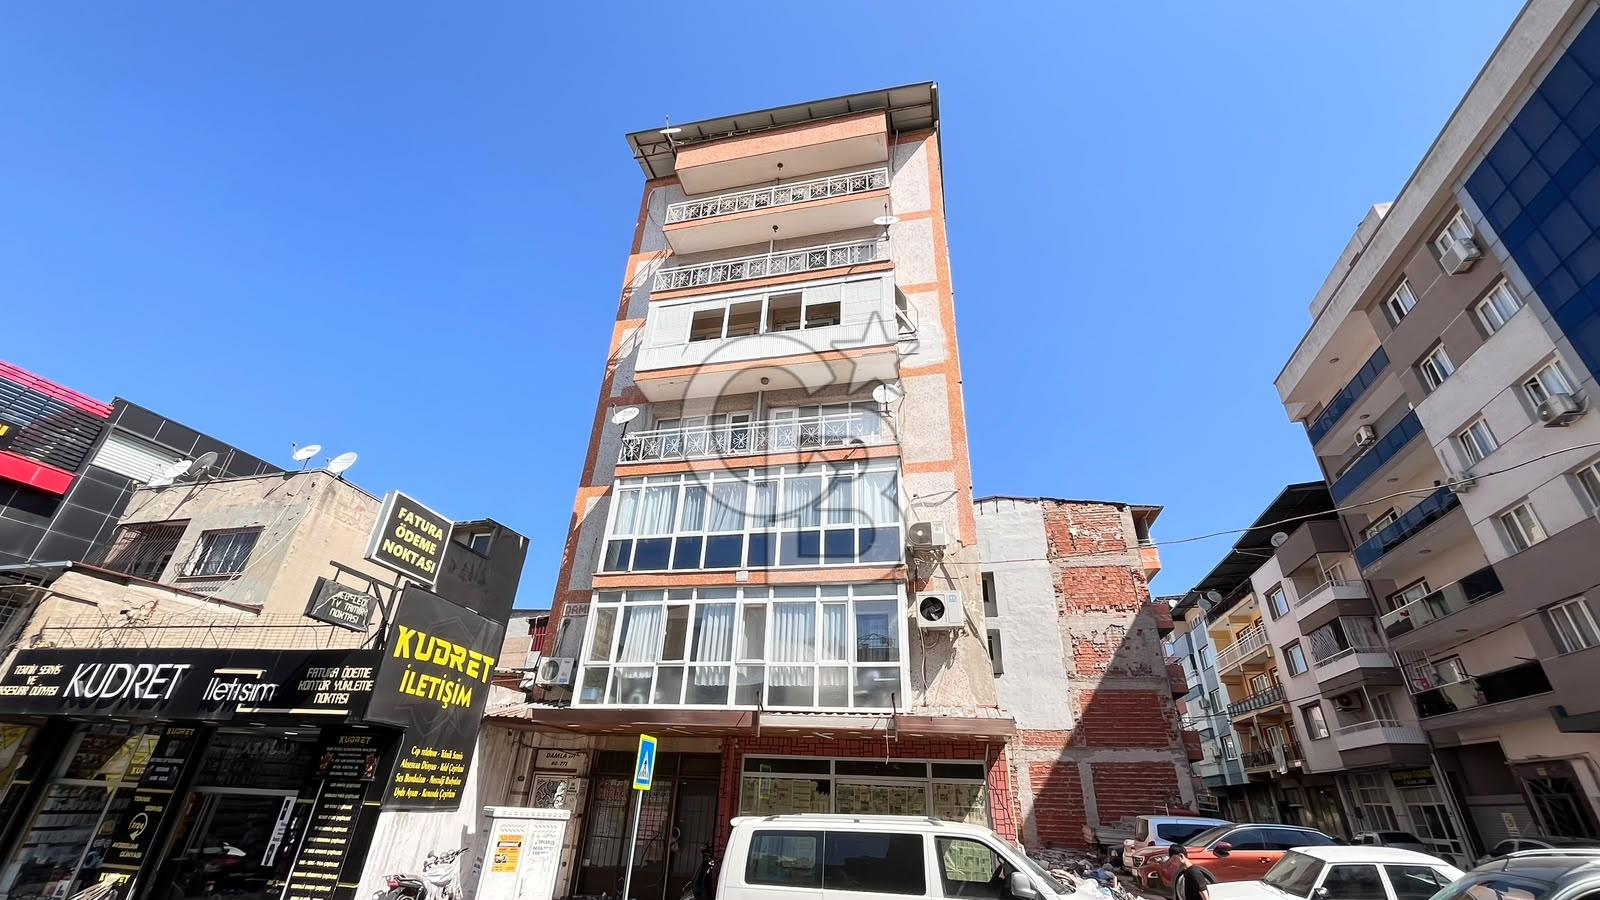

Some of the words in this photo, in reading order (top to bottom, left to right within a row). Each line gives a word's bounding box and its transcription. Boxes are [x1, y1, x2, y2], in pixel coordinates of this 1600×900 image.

[398, 507, 443, 541] FATURA
[395, 522, 437, 555] ÖDEME
[382, 538, 436, 574] NOKTASI
[331, 598, 342, 608] TV
[328, 608, 360, 625] NOKTASI
[393, 625, 495, 684] KUDRET
[38, 664, 64, 675] SERVİS
[307, 667, 340, 679] FATURA
[341, 665, 373, 680] ÖDEME
[26, 675, 38, 685] VE
[62, 663, 191, 700] KUDRET
[333, 678, 375, 692] YÜKLEME
[399, 663, 473, 709] İLETİŞİM
[313, 692, 350, 705] NOKTASI
[338, 735, 373, 745] KUDRET
